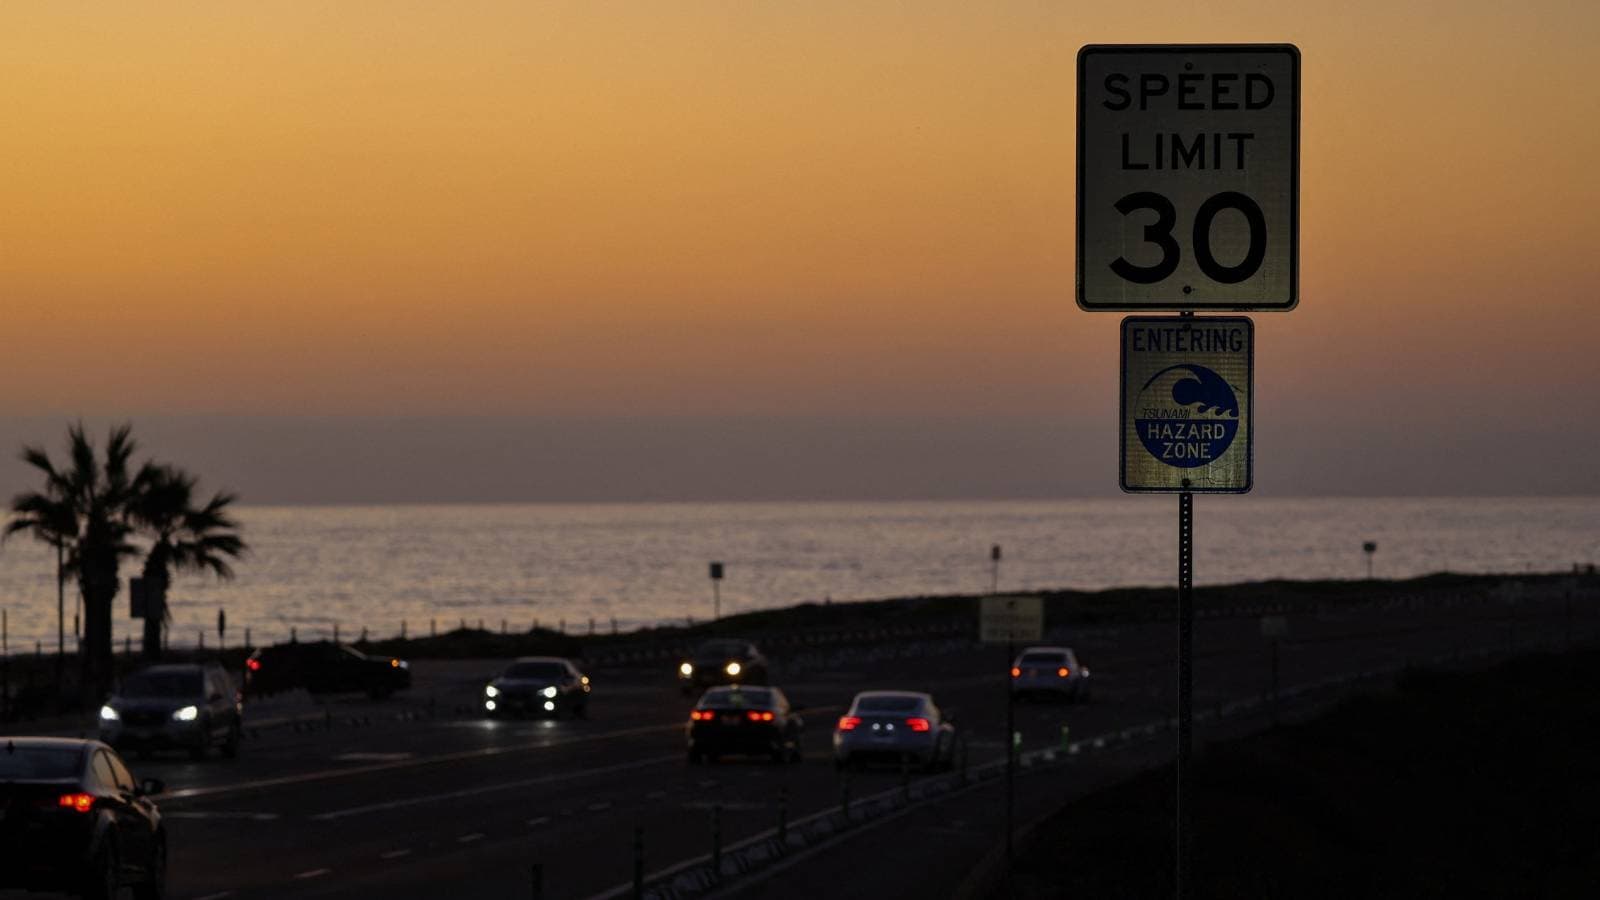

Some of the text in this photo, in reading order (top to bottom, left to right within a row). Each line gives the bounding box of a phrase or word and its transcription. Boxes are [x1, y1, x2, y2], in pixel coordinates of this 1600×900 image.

[1103, 74, 1275, 110] SPEED
[1122, 134, 1254, 170] LIMIT
[1110, 192, 1267, 284] 30
[1133, 328, 1242, 352] ENTERING
[1143, 408, 1191, 419] TSUNAMI
[1147, 423, 1226, 440] HAZARD
[1162, 443, 1212, 459] ZONE
